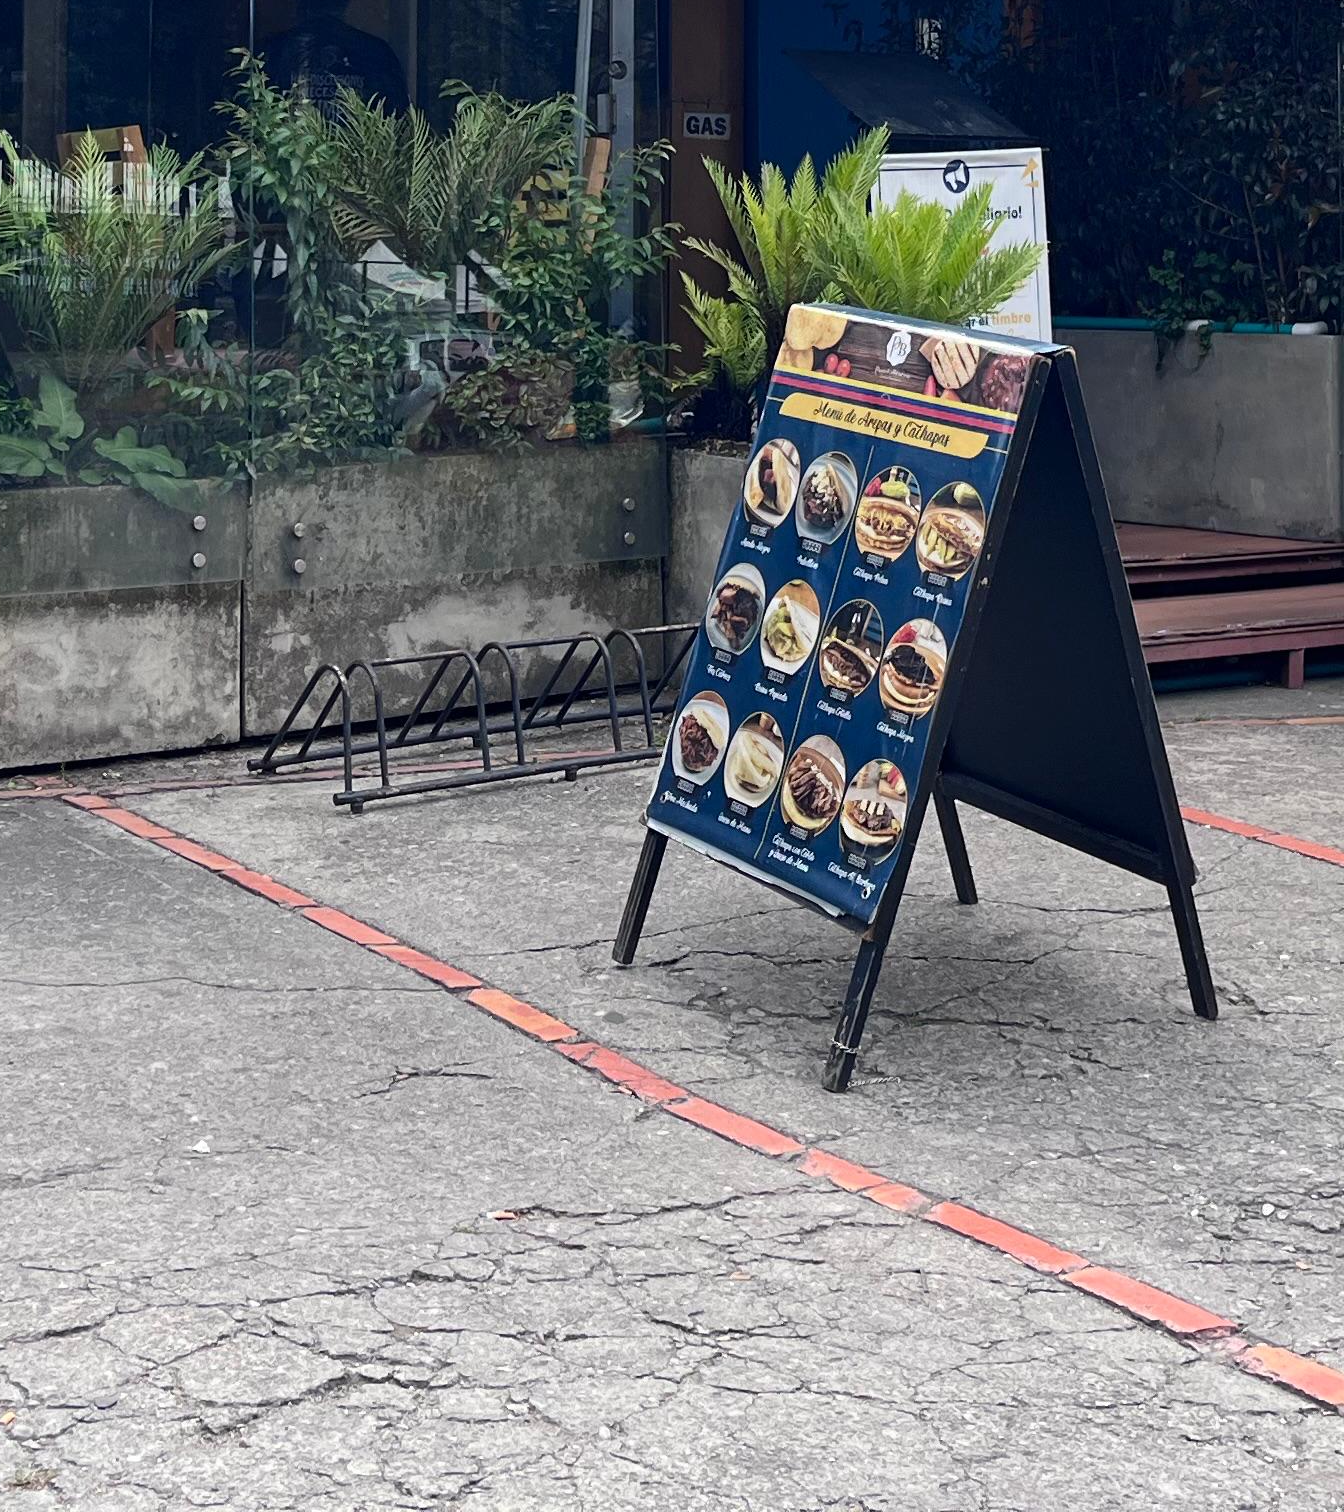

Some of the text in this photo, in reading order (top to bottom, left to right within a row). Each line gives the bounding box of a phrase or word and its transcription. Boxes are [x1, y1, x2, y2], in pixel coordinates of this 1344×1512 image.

[686, 116, 728, 136] GAS
[992, 312, 1032, 326] timbre
[844, 407, 857, 424] de
[858, 411, 894, 435] Arepas
[895, 424, 902, 438] y
